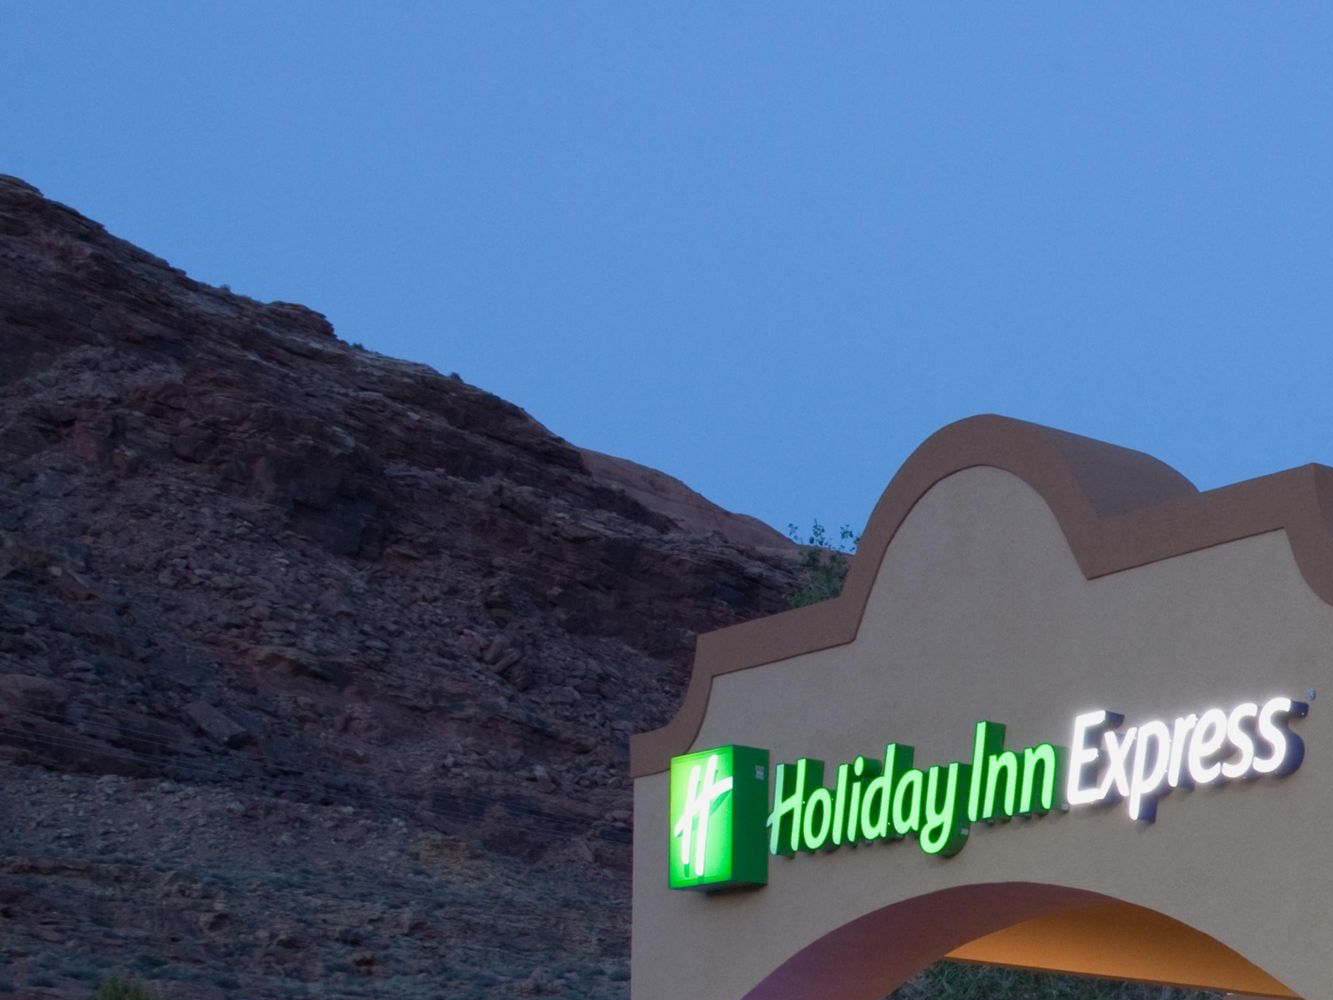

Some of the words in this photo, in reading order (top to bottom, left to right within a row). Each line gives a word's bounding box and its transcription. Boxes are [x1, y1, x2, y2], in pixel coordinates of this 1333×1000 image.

[766, 743, 962, 854] Holiday
[967, 720, 1057, 822] Inn
[1066, 697, 1294, 821] Express
